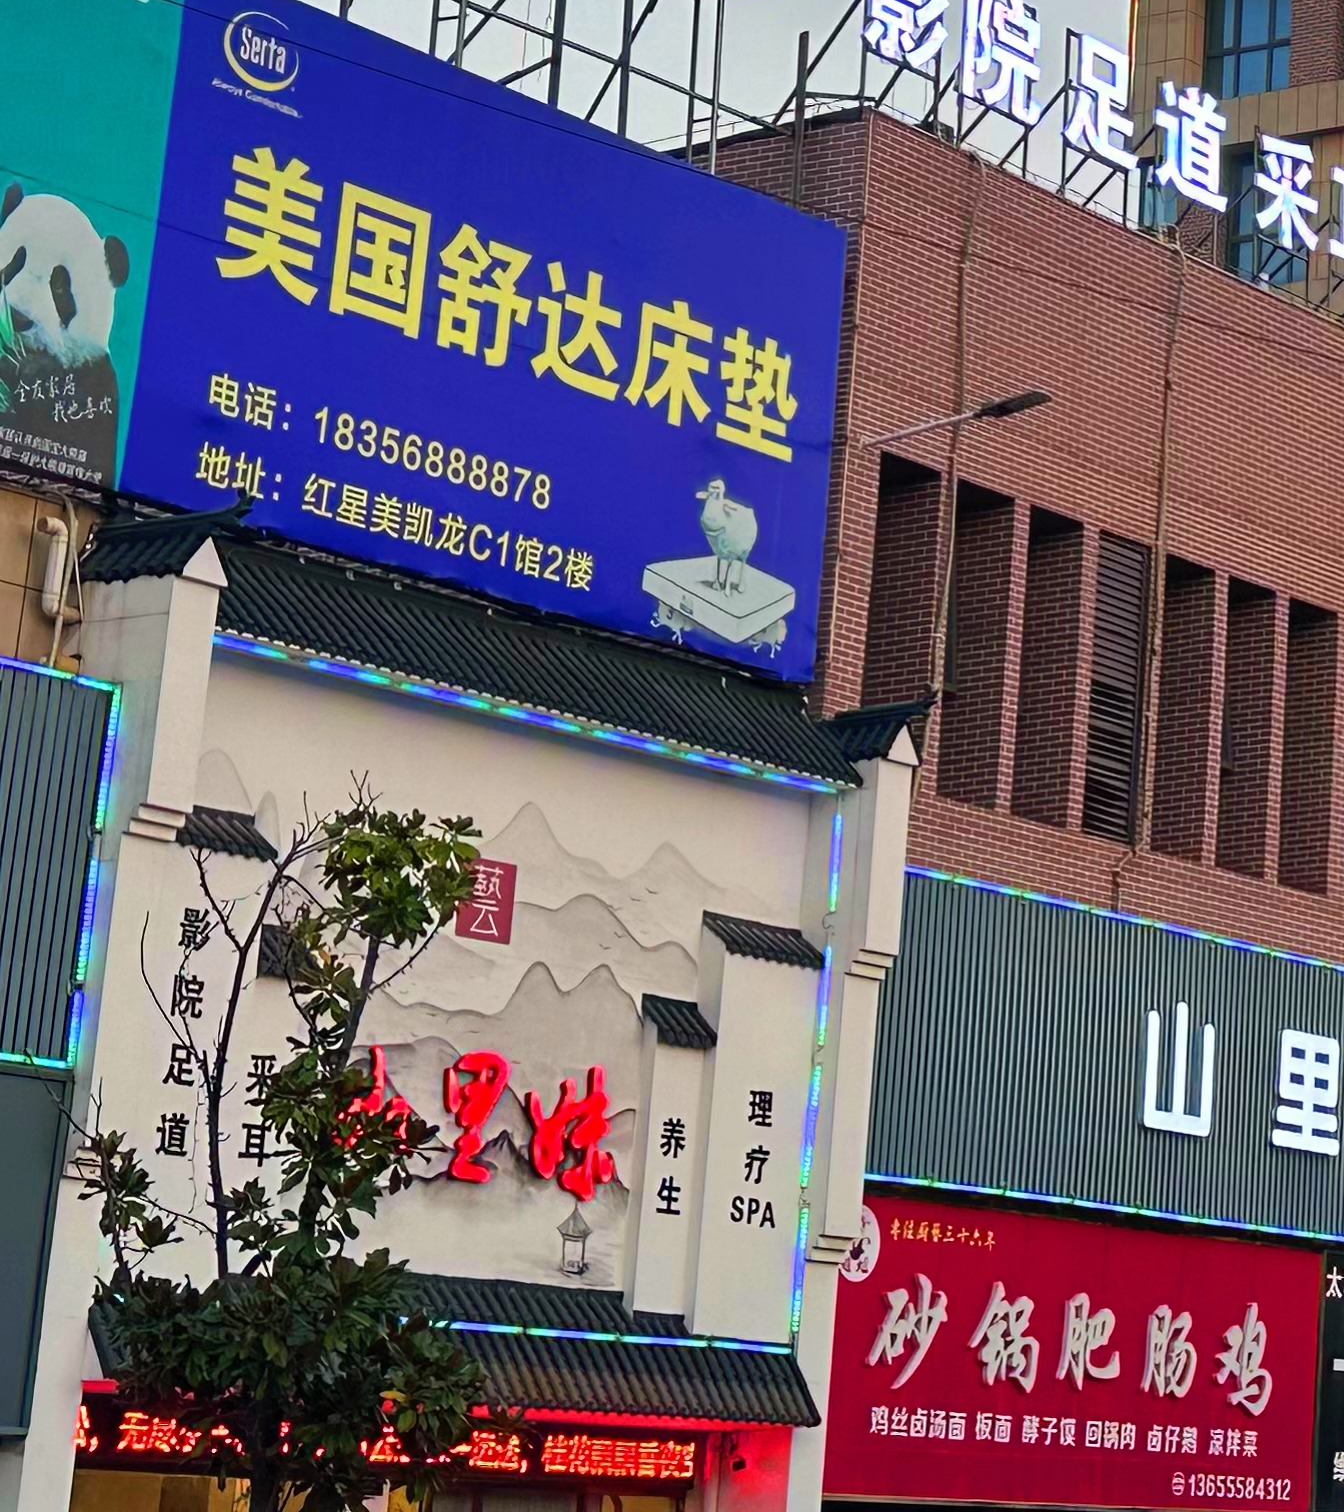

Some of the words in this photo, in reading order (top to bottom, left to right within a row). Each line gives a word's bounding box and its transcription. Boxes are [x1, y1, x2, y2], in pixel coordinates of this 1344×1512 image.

[239, 25, 287, 75] Serta
[215, 145, 799, 464] 美国舒达床垫
[155, 907, 211, 1157] 影院足道
[655, 1117, 686, 1216] 养生
[743, 1090, 773, 1185] 理疗
[730, 1195, 776, 1229] SPA
[864, 1273, 1273, 1417] 砂锅肥肠鸡
[1188, 1473, 1292, 1502] 13655584312
